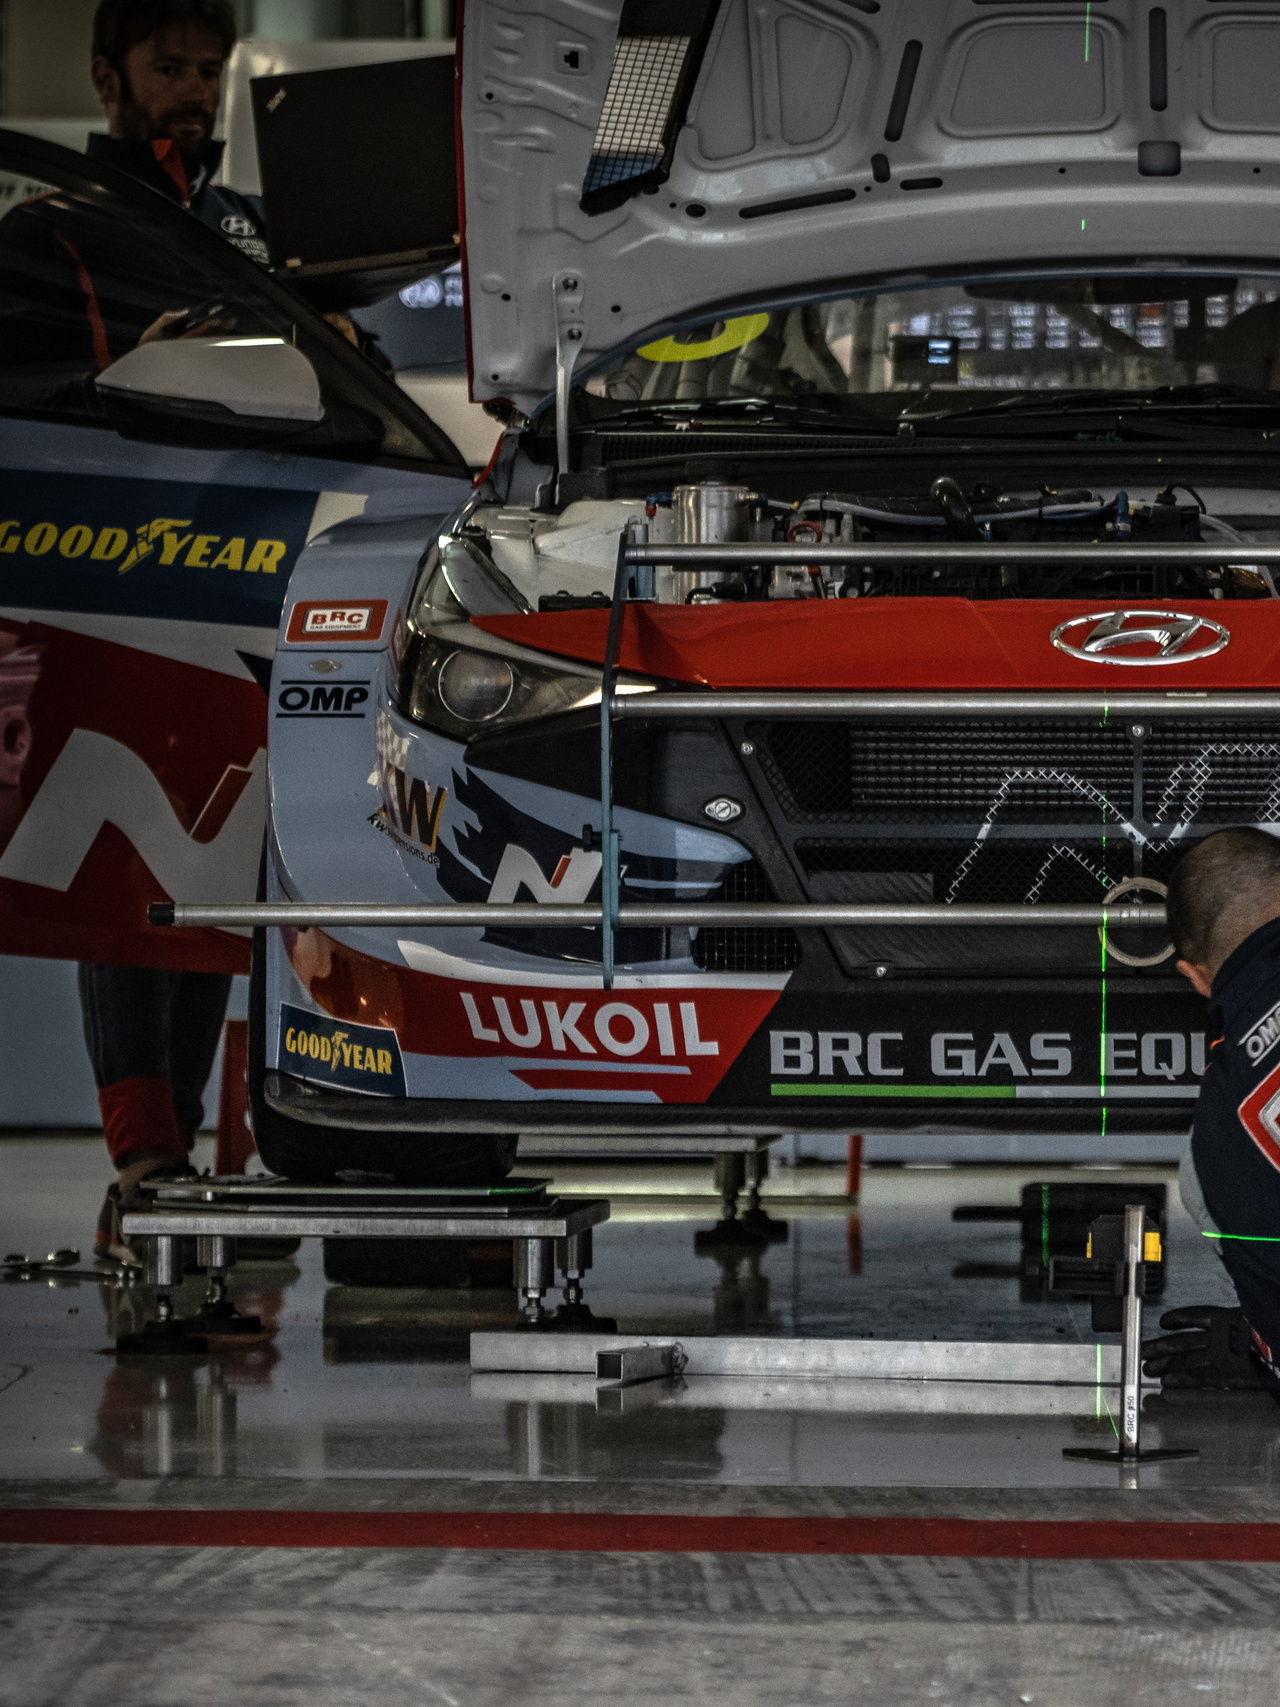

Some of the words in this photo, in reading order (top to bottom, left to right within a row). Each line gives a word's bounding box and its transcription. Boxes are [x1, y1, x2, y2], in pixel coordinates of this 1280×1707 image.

[311, 611, 364, 624] BRC
[278, 687, 368, 711] OMP
[460, 992, 719, 1057] LUKOIL
[285, 1027, 393, 1074] GOODYEAR
[769, 1031, 904, 1076] BRC
[930, 1033, 1071, 1076] GAS
